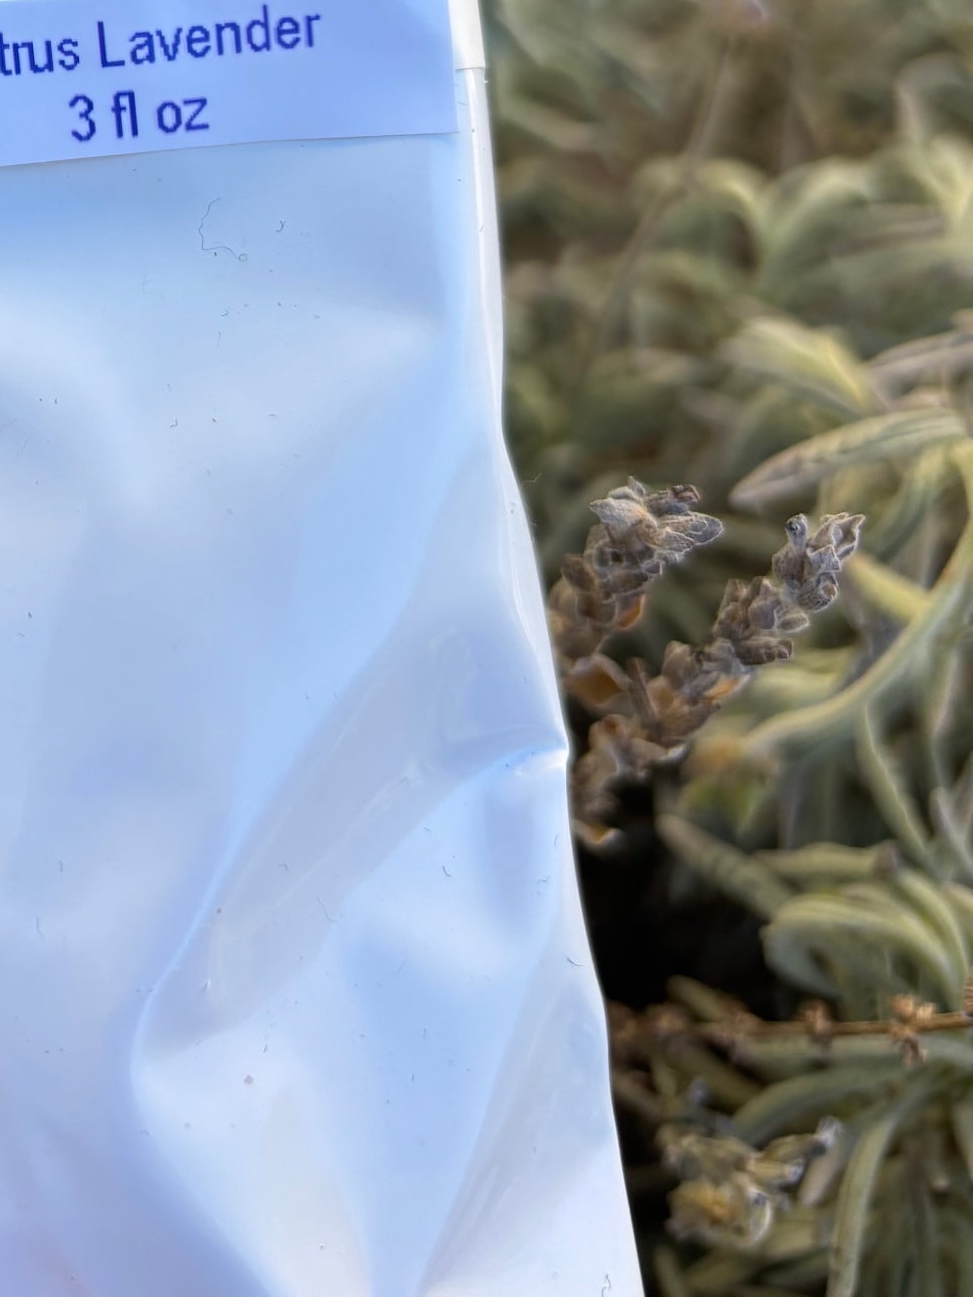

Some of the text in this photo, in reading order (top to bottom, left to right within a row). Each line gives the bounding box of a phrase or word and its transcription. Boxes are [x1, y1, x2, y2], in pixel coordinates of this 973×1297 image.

[98, 5, 322, 68] Lavender
[69, 90, 210, 143] 3 fl oz
